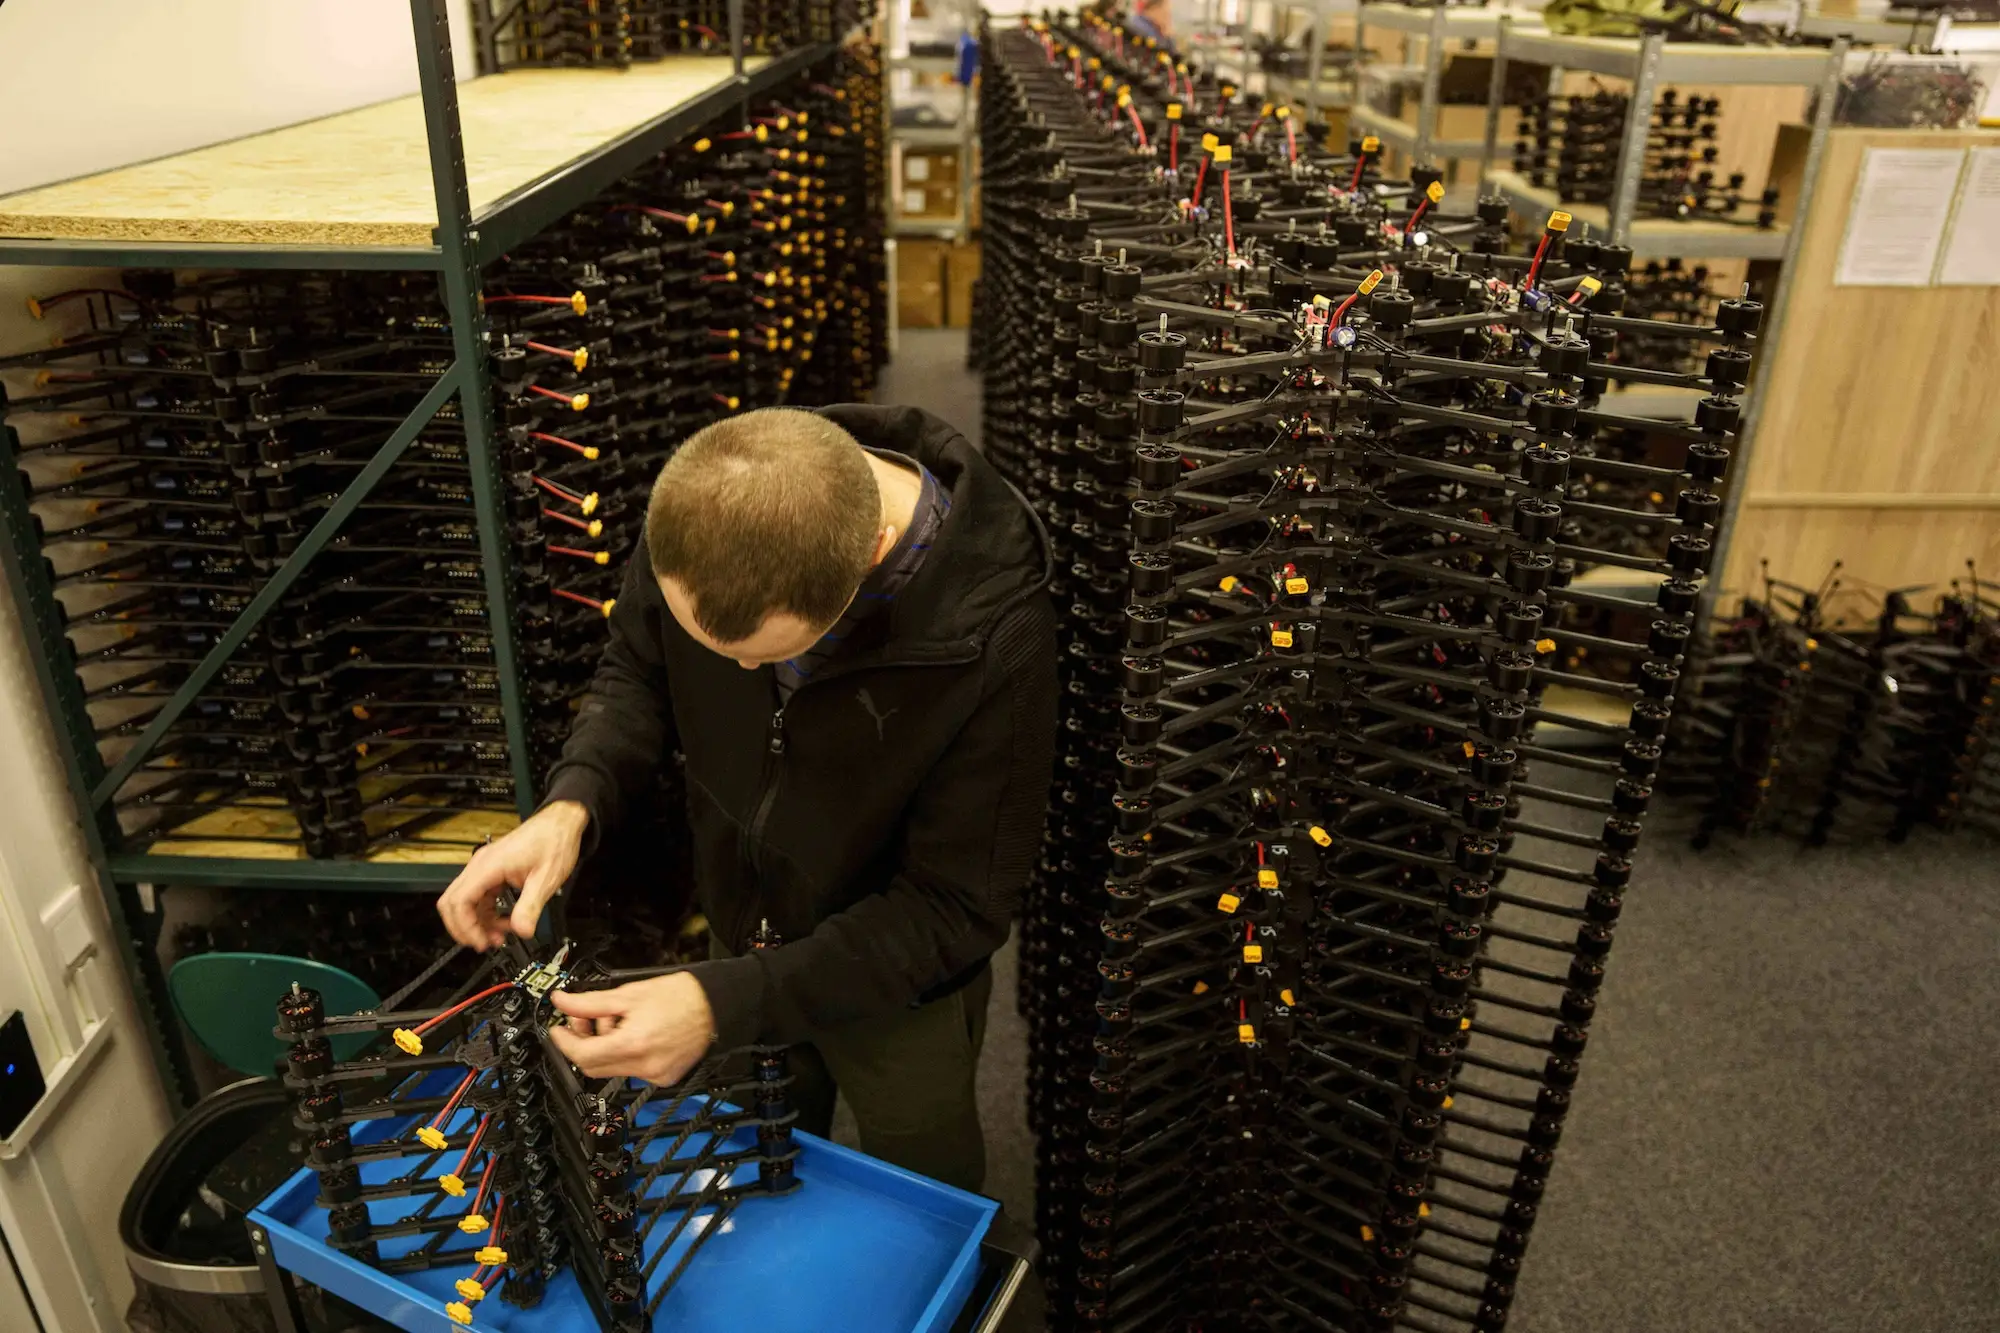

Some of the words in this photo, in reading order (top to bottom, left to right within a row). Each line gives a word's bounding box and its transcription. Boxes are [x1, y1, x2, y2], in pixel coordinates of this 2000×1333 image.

[1271, 844, 1289, 855] 15
[1275, 1006, 1291, 1017] 15
[503, 1026, 518, 1041] 39
[512, 1068, 526, 1082] 39
[524, 1152, 538, 1165] 39
